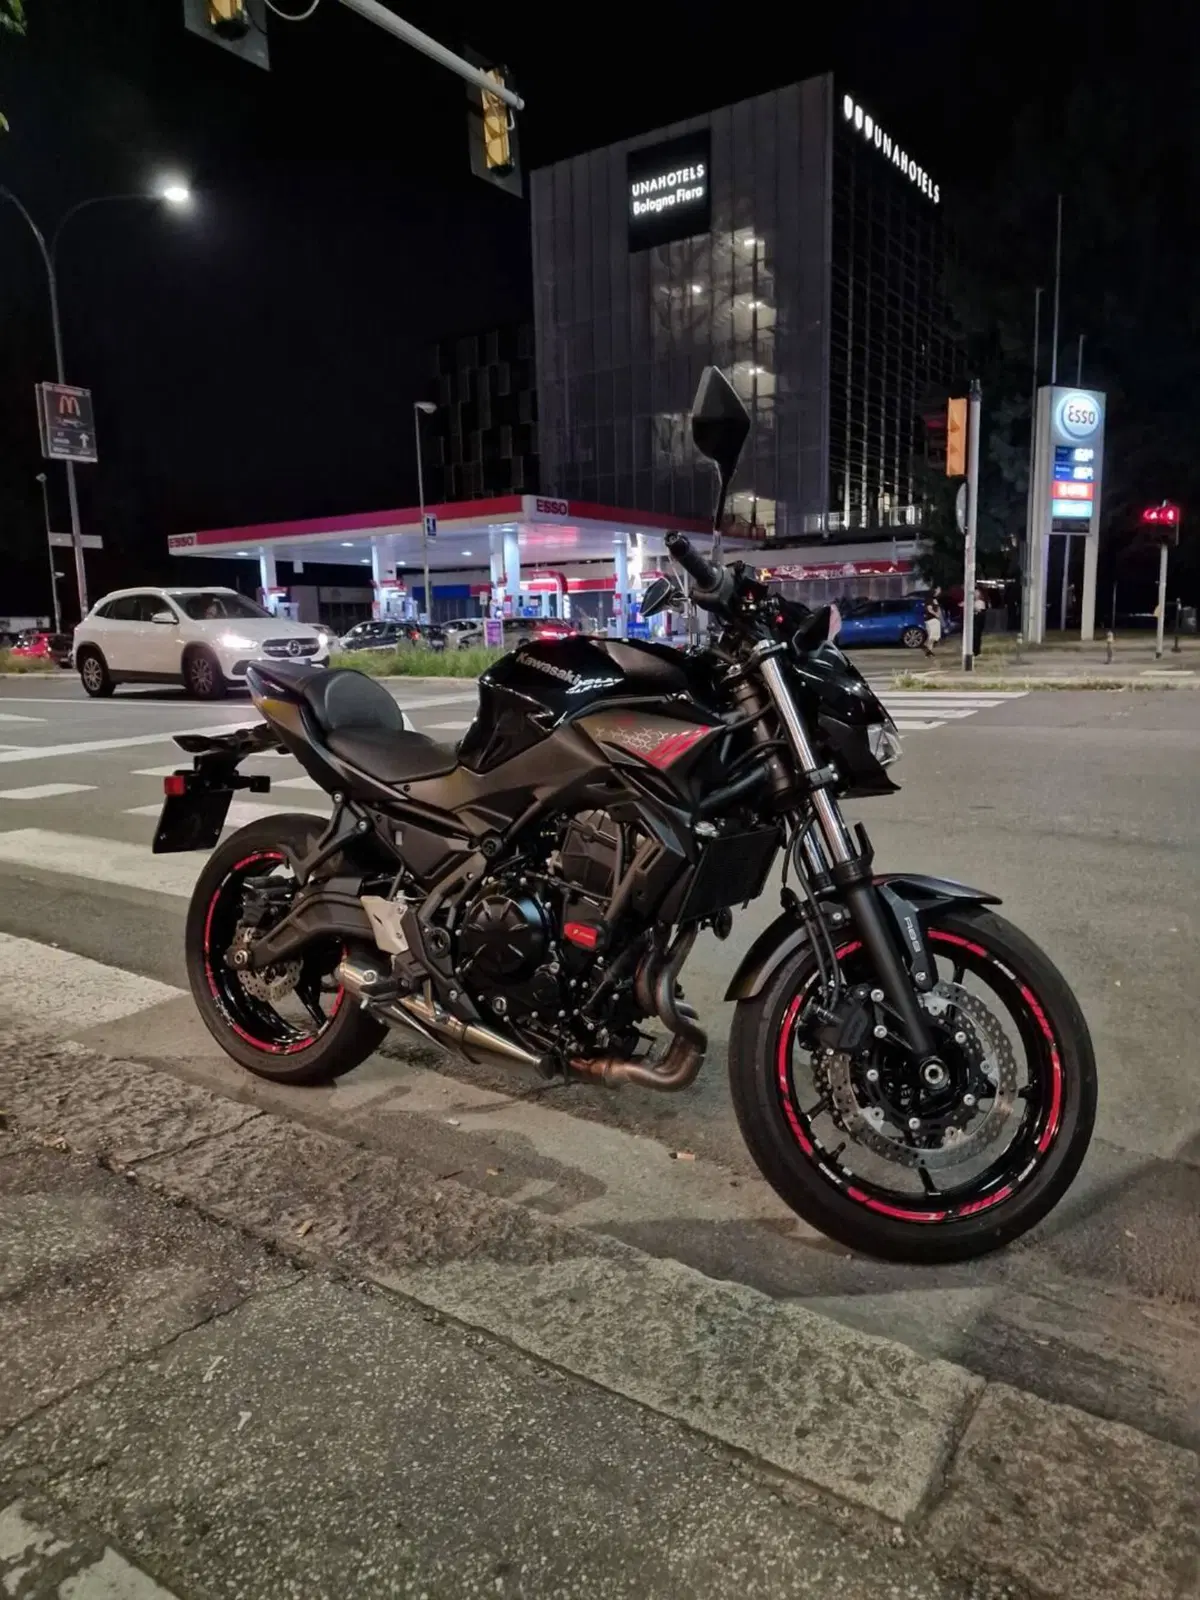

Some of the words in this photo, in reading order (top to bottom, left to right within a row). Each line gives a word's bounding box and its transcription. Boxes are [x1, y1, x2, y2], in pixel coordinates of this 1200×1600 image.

[632, 164, 704, 196] UNAHOTELS
[874, 125, 940, 203] UNAHOTELS
[633, 195, 675, 215] Bologna
[676, 187, 703, 202] Fiera
[515, 651, 582, 686] Kawasaki
